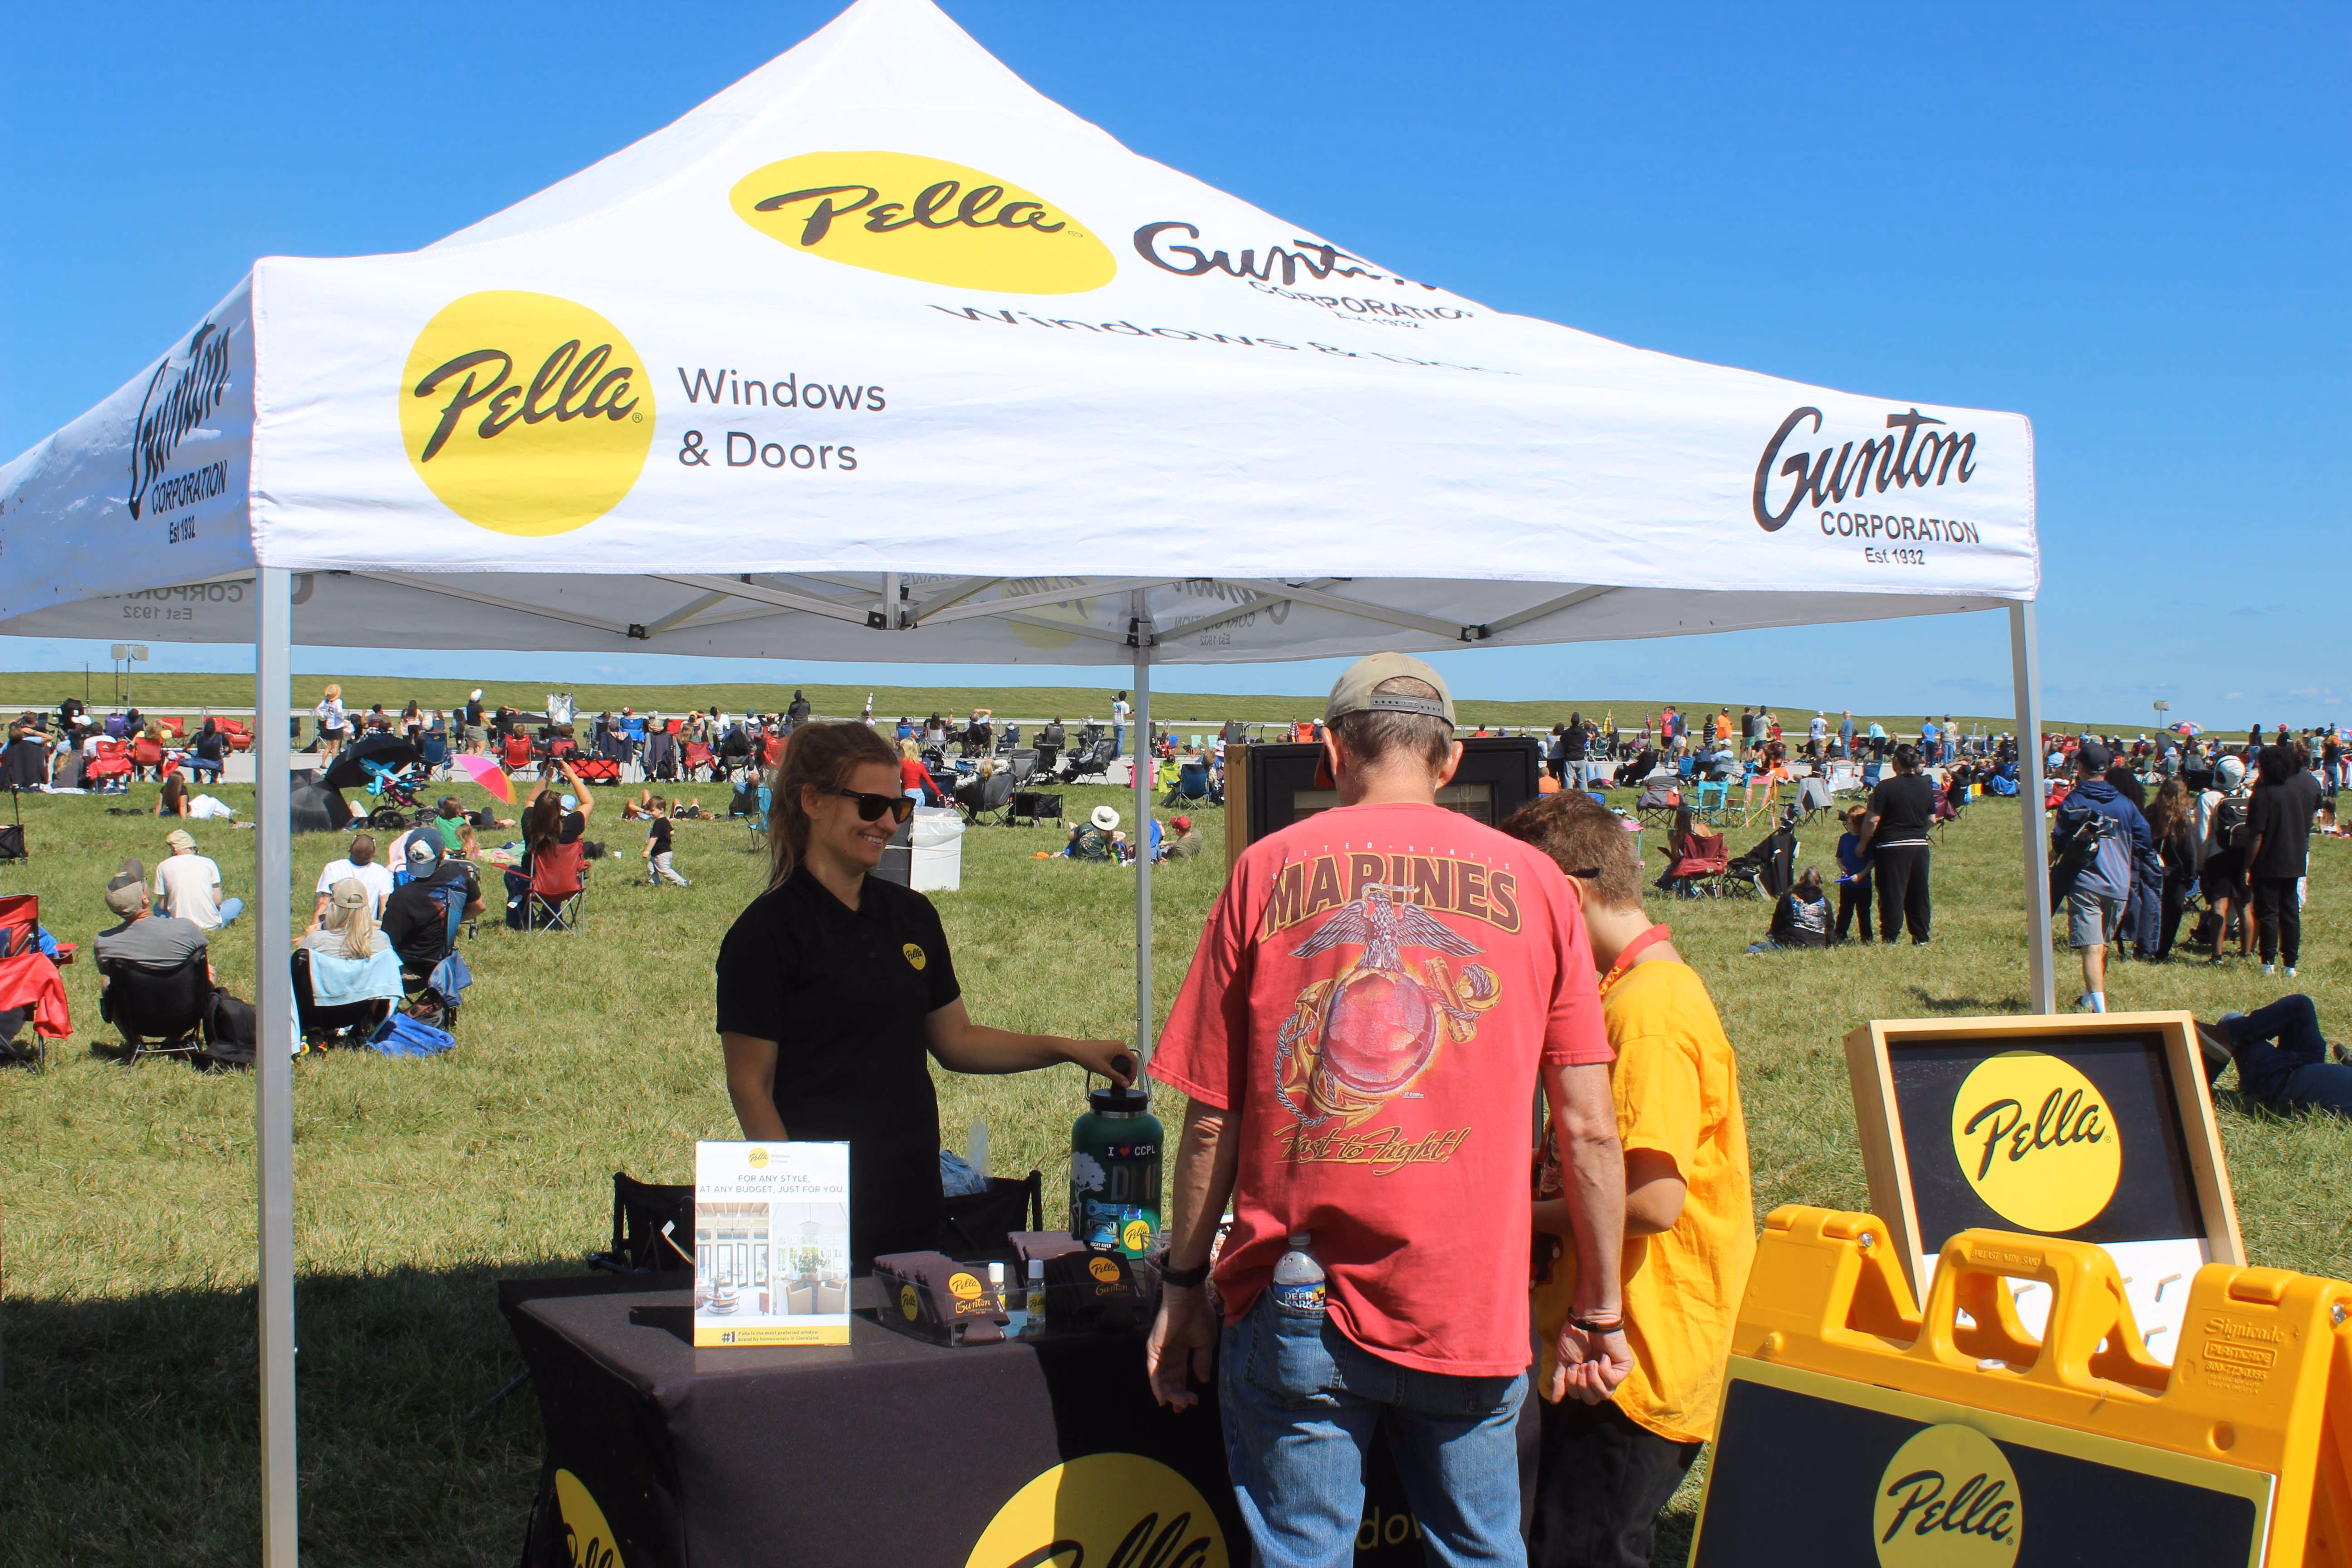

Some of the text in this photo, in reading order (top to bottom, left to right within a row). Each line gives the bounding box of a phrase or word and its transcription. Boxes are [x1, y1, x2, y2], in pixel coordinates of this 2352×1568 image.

[755, 181, 1065, 246] Pella
[925, 304, 1299, 350] Windows
[414, 339, 639, 464] Pella
[677, 367, 887, 412] Windows
[128, 314, 231, 520] Gunton
[679, 430, 858, 470] & Doors
[1753, 406, 1976, 532] Gunton
[152, 460, 227, 515] CORPORATION
[169, 515, 196, 544] Est 1932
[1820, 510, 1980, 544] CORPORATION
[1864, 547, 1925, 565] Est 1932
[1272, 842, 1509, 880] UNITED STATES
[1259, 852, 1521, 942] MARINES
[906, 948, 923, 961] Pella
[1338, 1135, 1371, 1159] to
[1964, 1088, 2106, 1181] Pella
[749, 1152, 767, 1163] Pella
[1108, 1145, 1156, 1156] I CCPL
[781, 1175, 810, 1183] STYLE,
[1092, 1263, 1117, 1275] Pella
[1971, 1249, 2000, 1260] BALLAST
[2004, 1254, 2019, 1263] WITH
[952, 1278, 979, 1293] Pella
[1096, 1284, 1128, 1296] Gunton
[1284, 1291, 1313, 1300] DEER
[956, 1298, 991, 1314] Gunton
[721, 1331, 735, 1343] #1
[2204, 1318, 2284, 1344] Signicade
[2210, 1343, 2272, 1364] PLASTICADE
[1882, 1470, 2014, 1544] Pella
